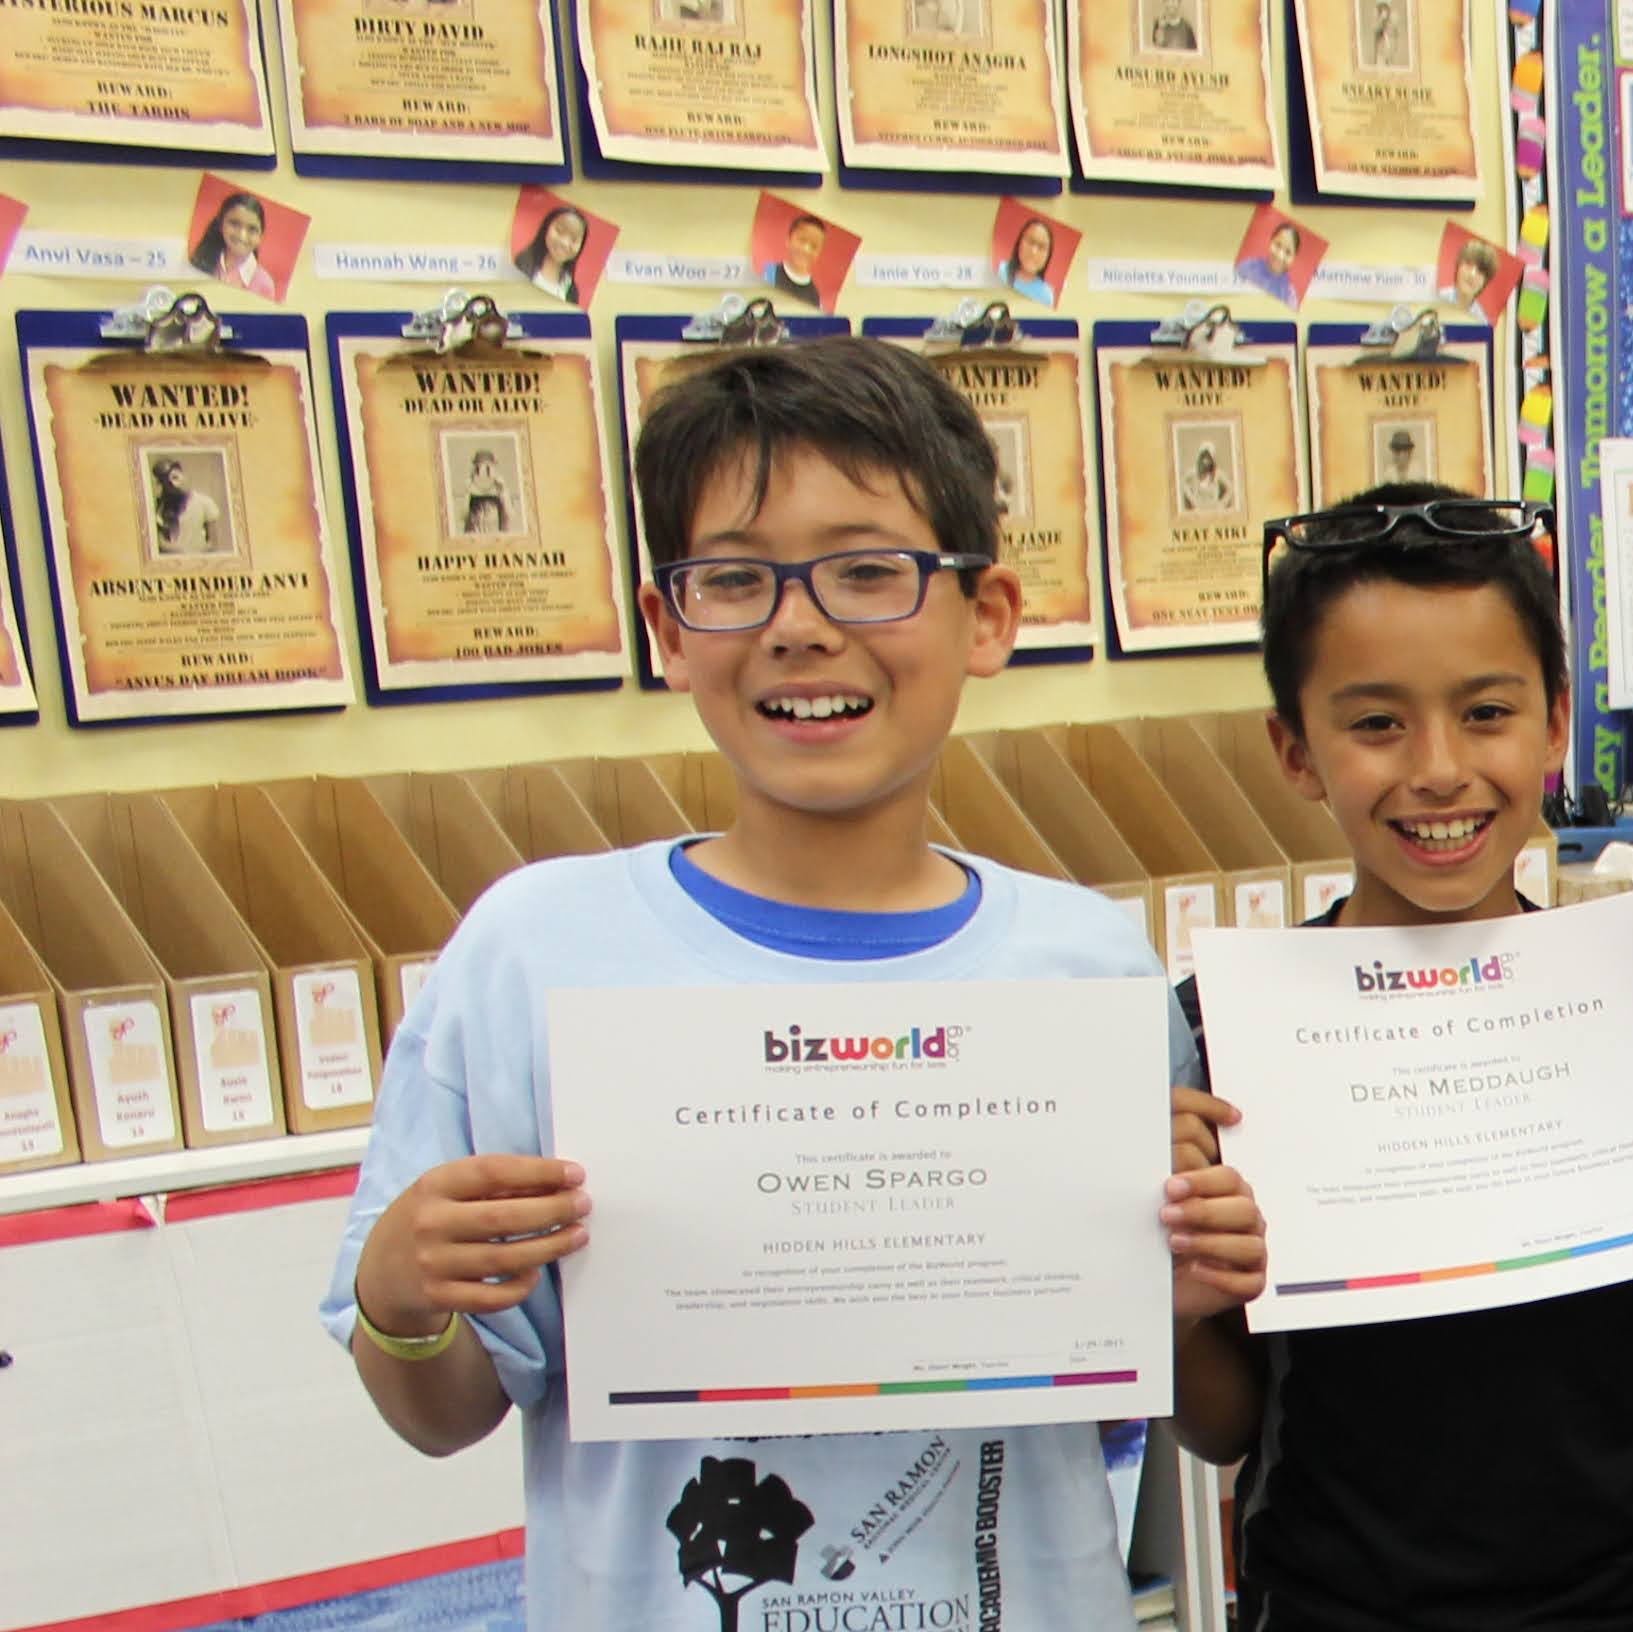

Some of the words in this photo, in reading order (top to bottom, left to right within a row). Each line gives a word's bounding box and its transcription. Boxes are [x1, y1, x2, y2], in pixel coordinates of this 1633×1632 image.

[140, 5, 229, 26] MARCUS
[355, 18, 415, 34] DIRTY
[424, 22, 484, 40] DAVID
[1573, 33, 1608, 208] Leader.
[1585, 218, 1607, 250] a
[25, 245, 69, 264] Anvi
[75, 248, 125, 266] Vasa
[336, 251, 396, 269] Hannah
[400, 252, 459, 272] Wang
[415, 372, 541, 394] WANTED!
[1154, 369, 1252, 391] WANTED!
[1358, 372, 1447, 391] WANTED!
[111, 385, 249, 408] WANTED!
[485, 552, 566, 568] HANNAH
[260, 573, 309, 592] ANVI
[1355, 956, 1501, 992] bizworld
[1296, 1026, 1418, 1044] Certificate
[1433, 1020, 1453, 1036] of
[1467, 999, 1603, 1032] Completion
[765, 1025, 945, 1062] bizworld
[1350, 1083, 1417, 1102] DEAN
[1429, 1062, 1570, 1096] MEDDAUGH
[676, 1104, 834, 1125] Certificate
[852, 1100, 879, 1119] of
[895, 1097, 1056, 1119] Completion
[1378, 1139, 1428, 1152] HIDDEN
[1434, 1134, 1471, 1149] HILLS
[1475, 1120, 1562, 1144] ELEMENTARY
[757, 1173, 850, 1193] OWEN
[866, 1168, 987, 1189] SPARGO
[763, 1240, 824, 1254] HIDDEN
[833, 1238, 876, 1251] HILLS
[884, 1233, 984, 1248] ELEMENTARY
[850, 1504, 885, 1545] SAN
[885, 1434, 947, 1505] RAMON
[976, 1440, 1004, 1529] BOOSTER
[762, 1597, 790, 1608] SAN
[798, 1592, 856, 1606] RAMON
[860, 1589, 915, 1602] VALLEY
